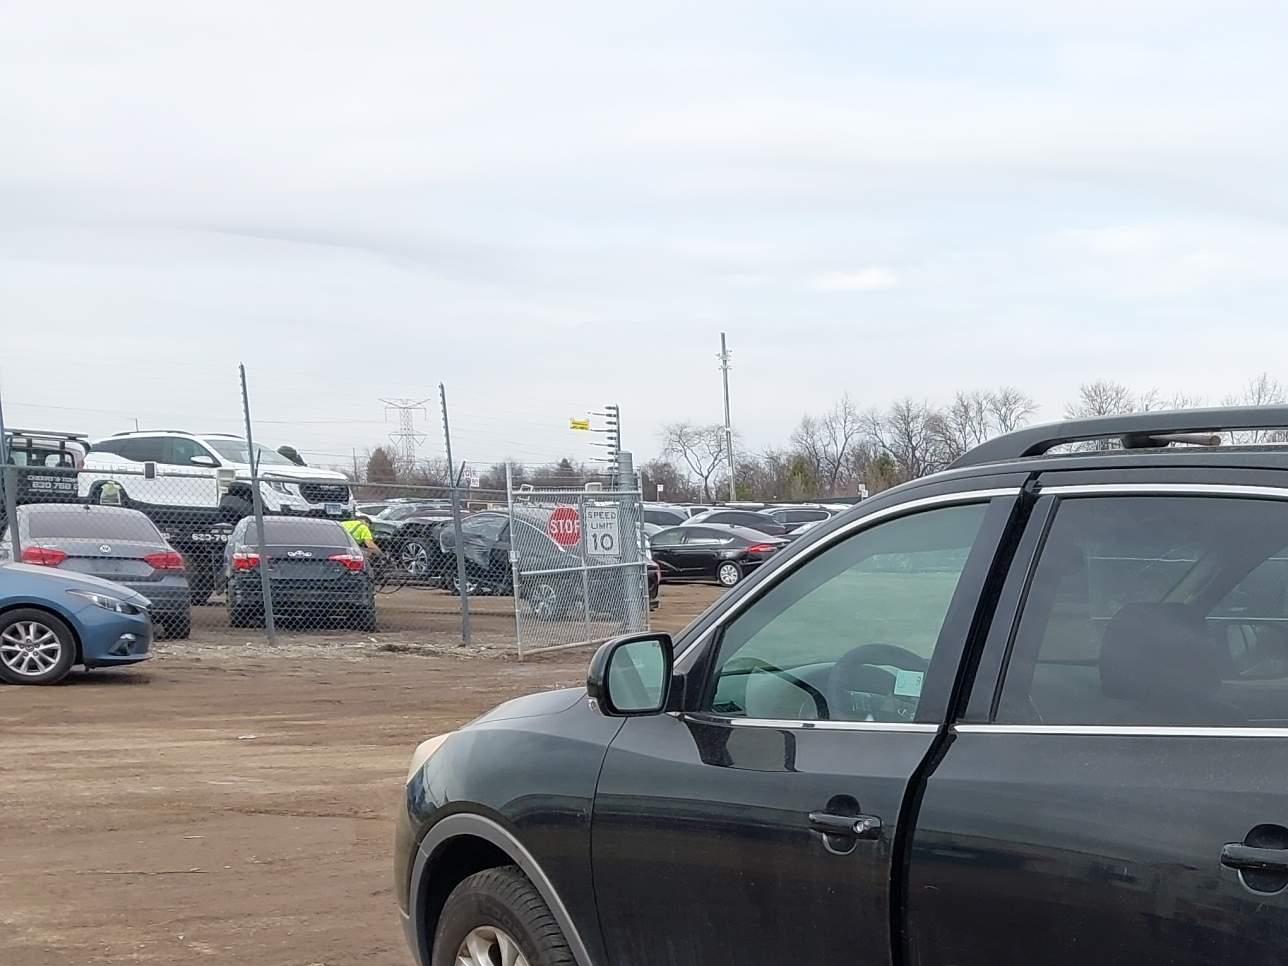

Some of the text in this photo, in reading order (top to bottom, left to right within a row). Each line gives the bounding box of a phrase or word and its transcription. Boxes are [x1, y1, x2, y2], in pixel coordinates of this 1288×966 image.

[587, 511, 617, 520] SPEED
[590, 522, 615, 530] LIMIT
[591, 532, 614, 551] 10
